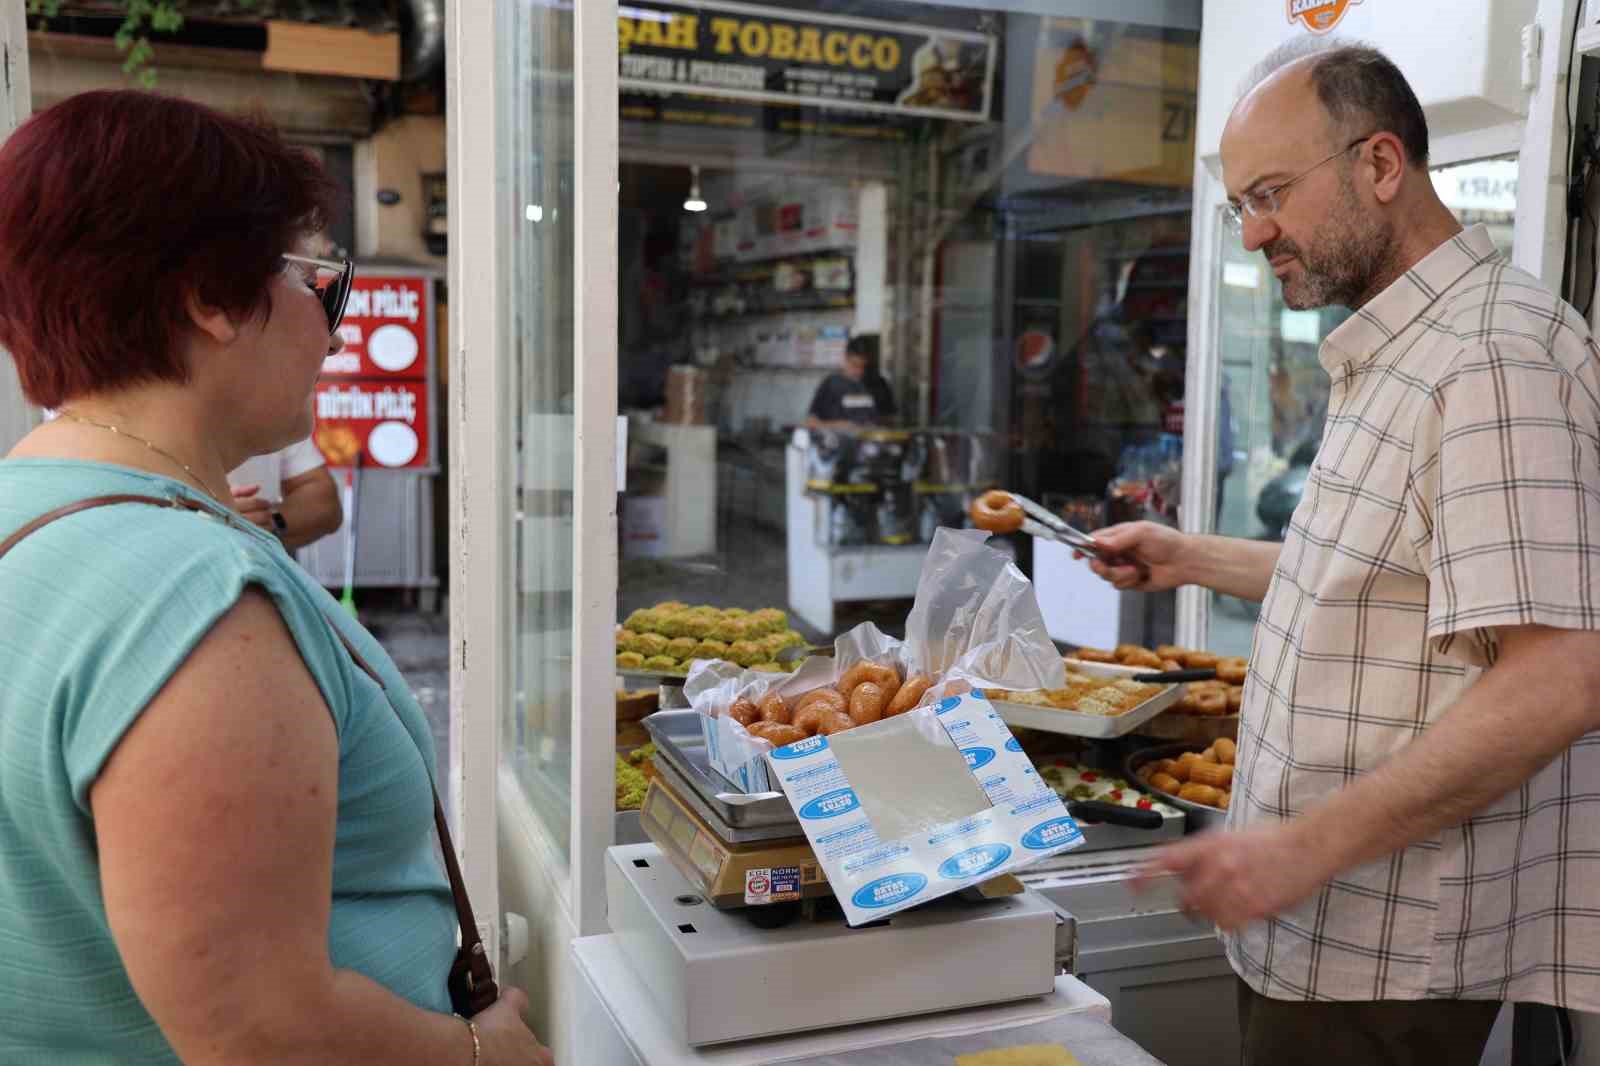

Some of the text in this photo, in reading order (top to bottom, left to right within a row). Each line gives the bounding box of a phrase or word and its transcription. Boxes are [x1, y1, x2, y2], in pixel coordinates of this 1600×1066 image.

[711, 17, 900, 72] TOBACCO
[371, 284, 420, 324] PİLİÇ
[374, 384, 417, 424] PİLİÇ
